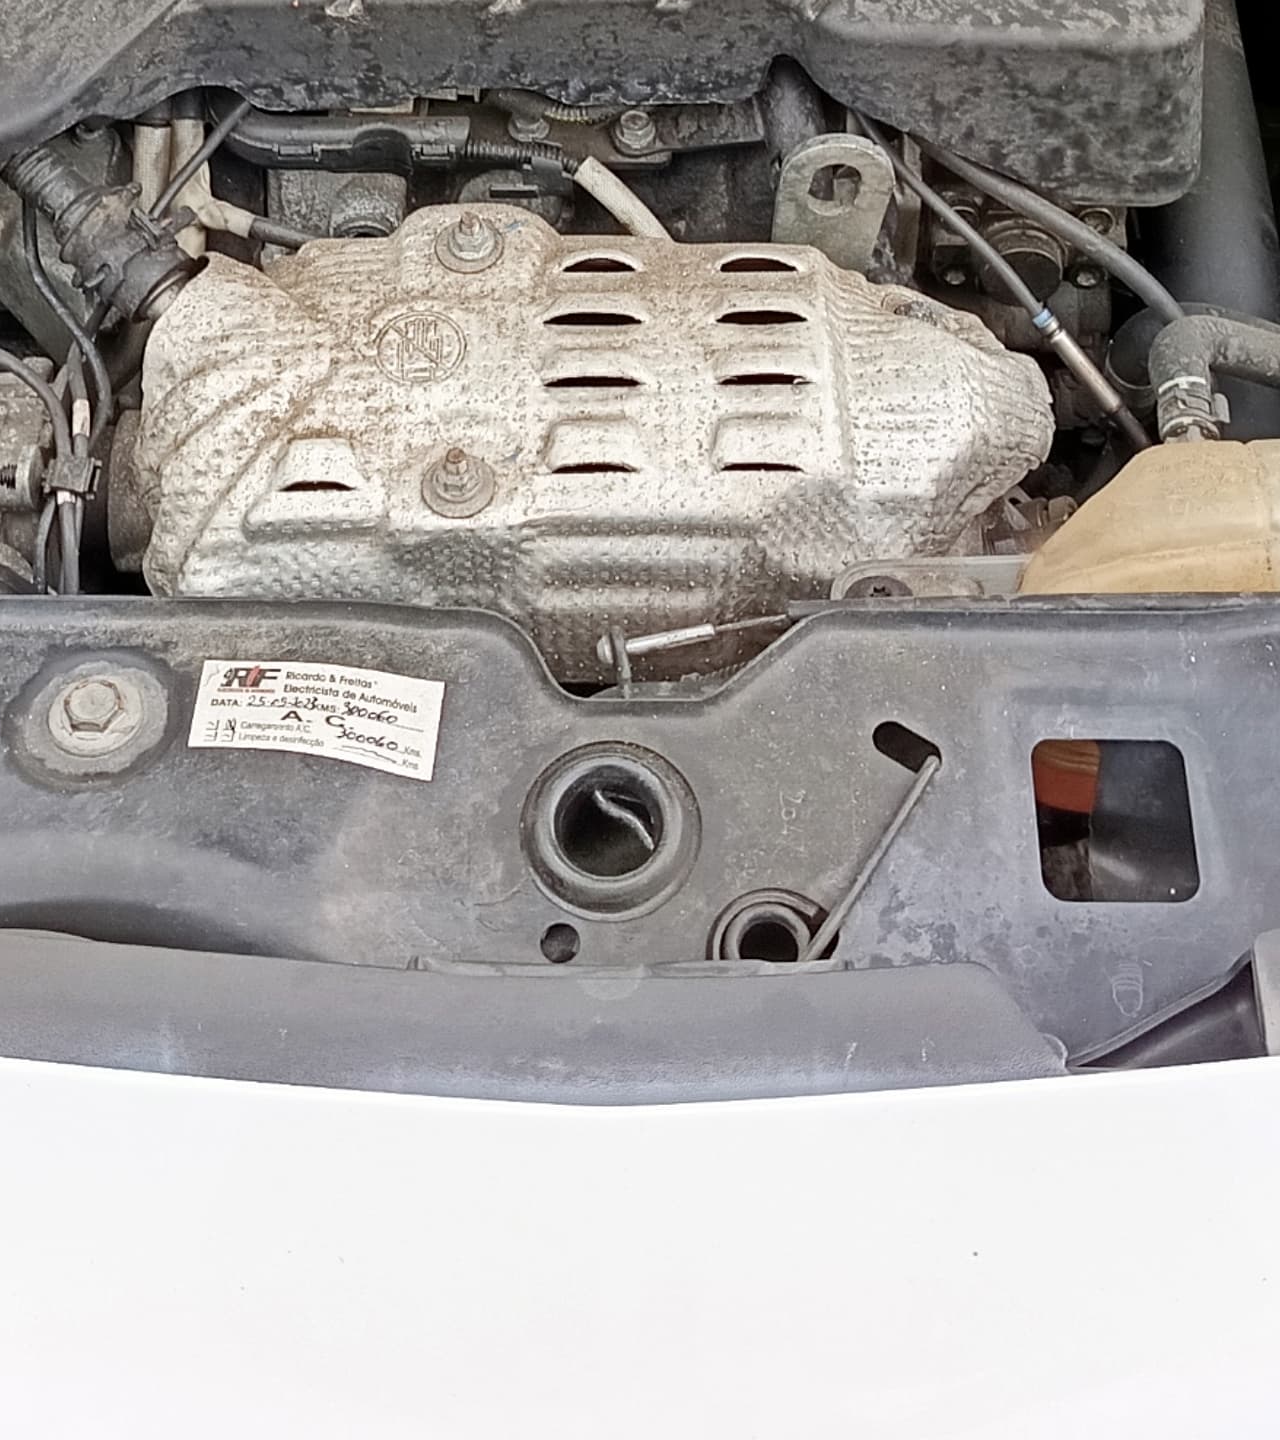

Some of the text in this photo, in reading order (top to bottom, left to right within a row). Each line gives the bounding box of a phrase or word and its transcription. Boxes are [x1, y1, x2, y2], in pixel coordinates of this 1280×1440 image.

[286, 671, 372, 689] Ricardo & Freitas
[284, 684, 417, 713] Electricista de Automóveis
